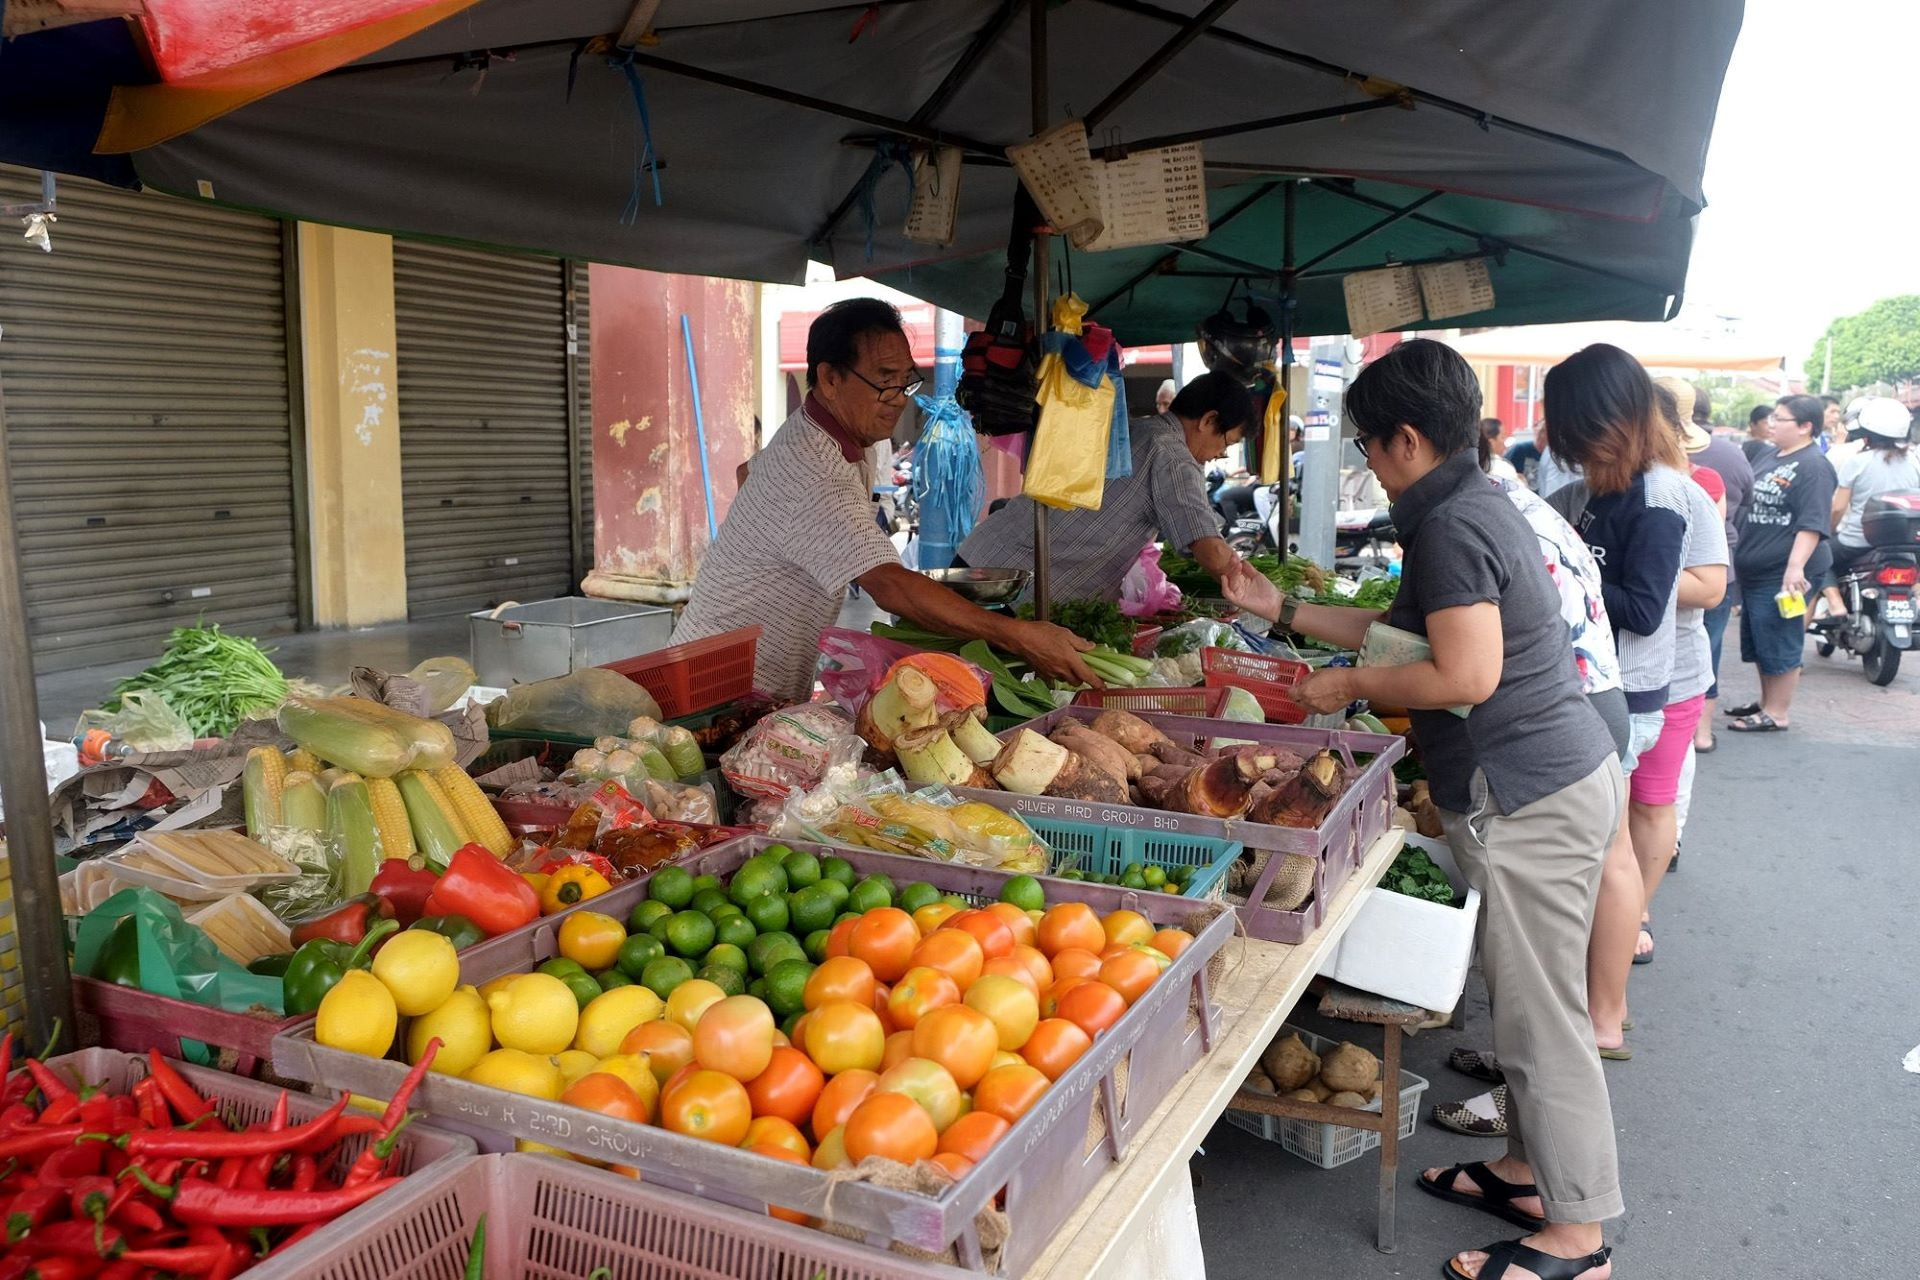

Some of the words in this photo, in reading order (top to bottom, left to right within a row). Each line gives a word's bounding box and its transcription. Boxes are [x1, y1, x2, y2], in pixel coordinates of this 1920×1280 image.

[1016, 799, 1056, 815] SILVER
[1064, 804, 1093, 820] BIRD
[1101, 808, 1144, 826] GROUP
[1154, 816, 1180, 832] BHD
[586, 1125, 652, 1158] GROUP
